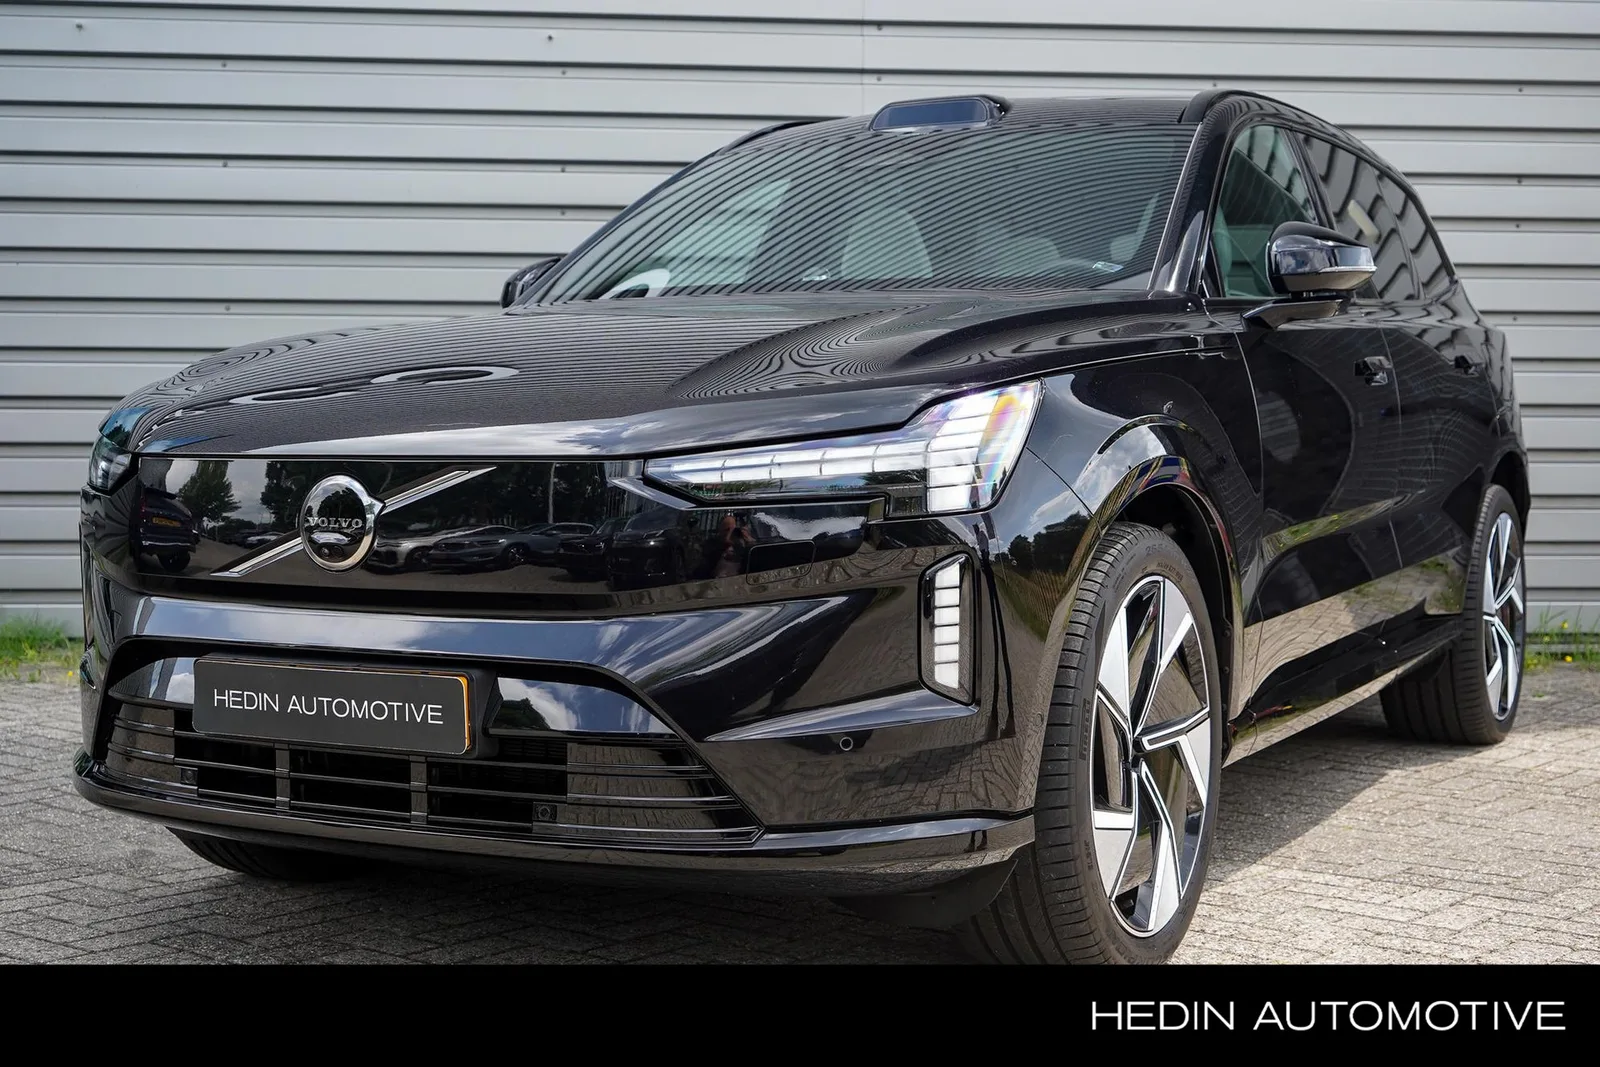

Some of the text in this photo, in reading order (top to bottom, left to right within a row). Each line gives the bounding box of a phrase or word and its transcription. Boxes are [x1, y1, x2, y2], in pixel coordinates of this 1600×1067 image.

[307, 516, 363, 529] VOLVO
[213, 688, 444, 725] HEDIN AUTOMOTIVE
